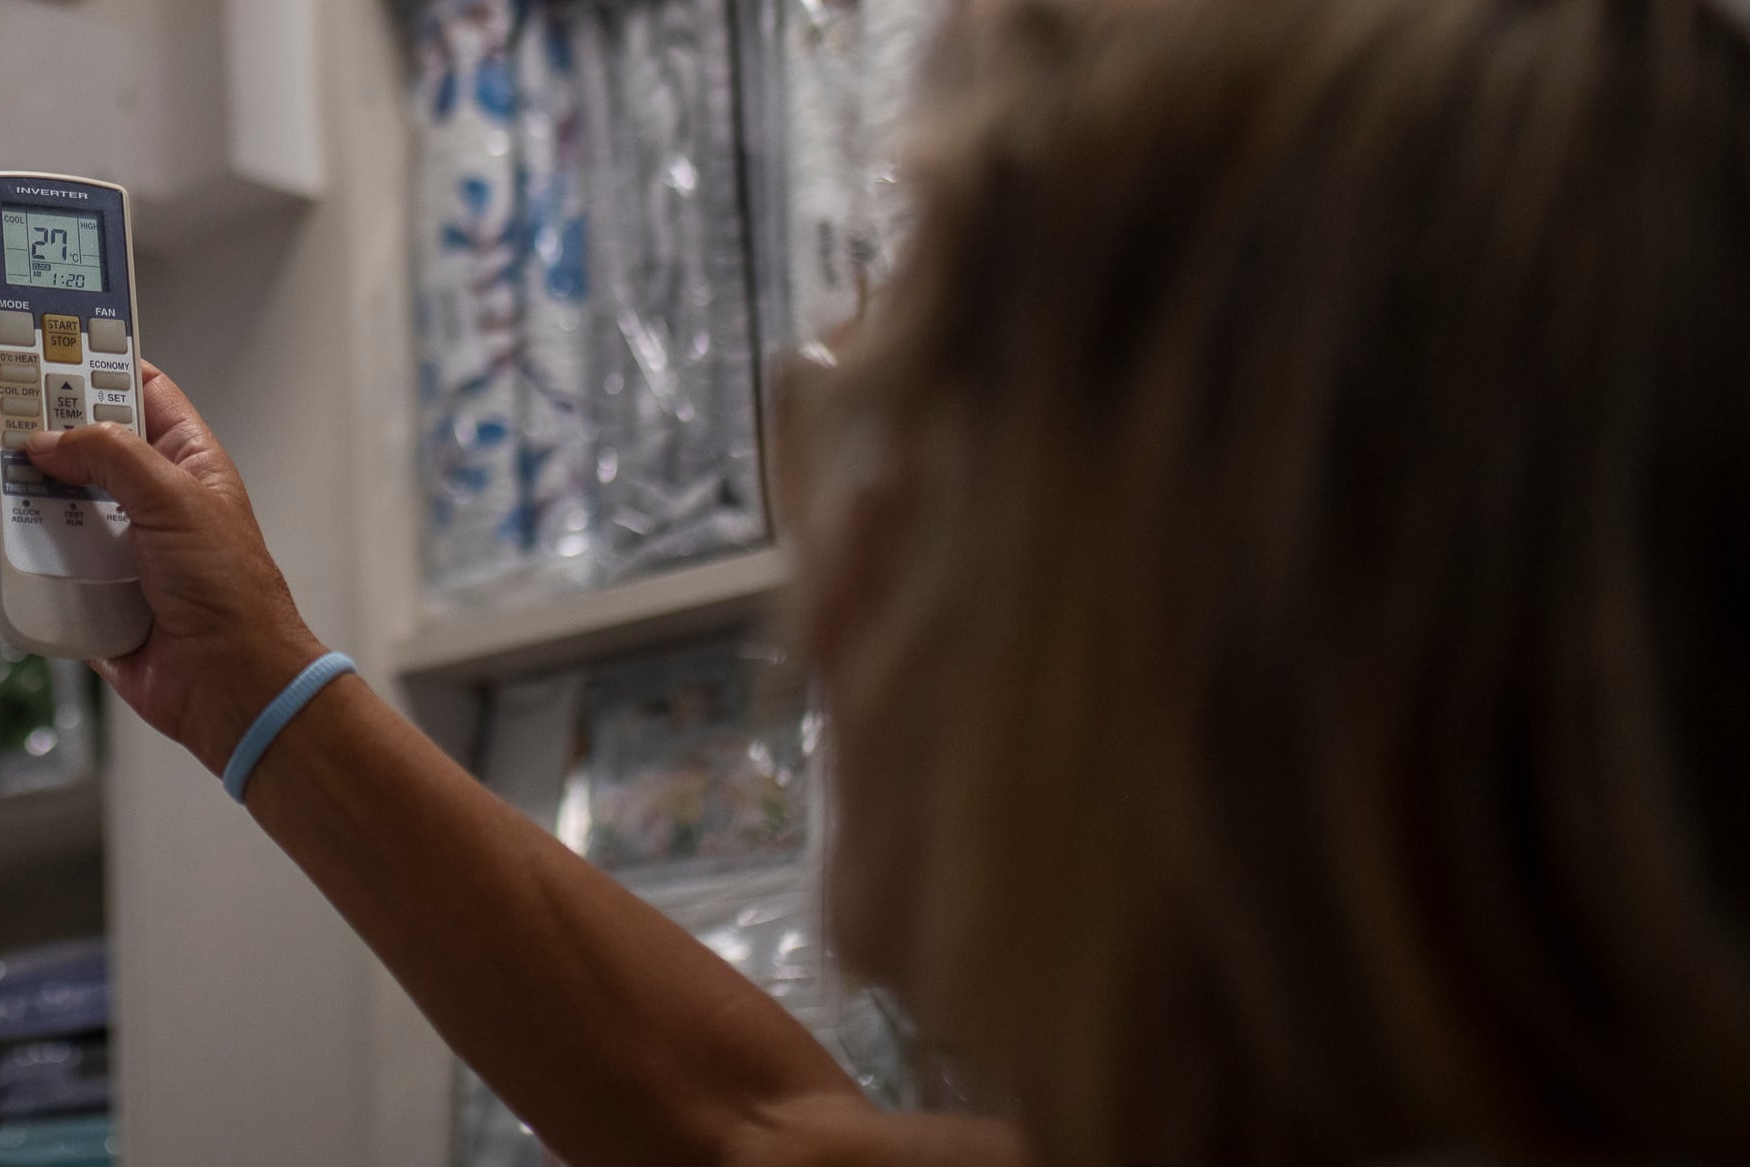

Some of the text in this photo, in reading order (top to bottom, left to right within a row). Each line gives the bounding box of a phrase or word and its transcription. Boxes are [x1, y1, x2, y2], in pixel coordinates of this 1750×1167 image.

[16, 186, 88, 200] INVERTER
[4, 215, 25, 225] COOL
[80, 222, 99, 231] HIGH
[32, 227, 67, 261] 27
[53, 273, 86, 289] 1:20
[95, 308, 116, 317] FAN
[47, 319, 78, 332] START
[51, 336, 77, 348] STOP
[15, 354, 39, 364] HEAT
[90, 360, 130, 371] ECONOMY
[21, 388, 41, 397] DRY
[57, 397, 78, 407] SET
[107, 393, 127, 403] SET
[5, 420, 38, 431] SLEEP
[12, 507, 41, 517] CLOCK
[64, 511, 84, 519] TEST
[11, 516, 43, 525] ADJUST
[106, 514, 129, 522] RESE
